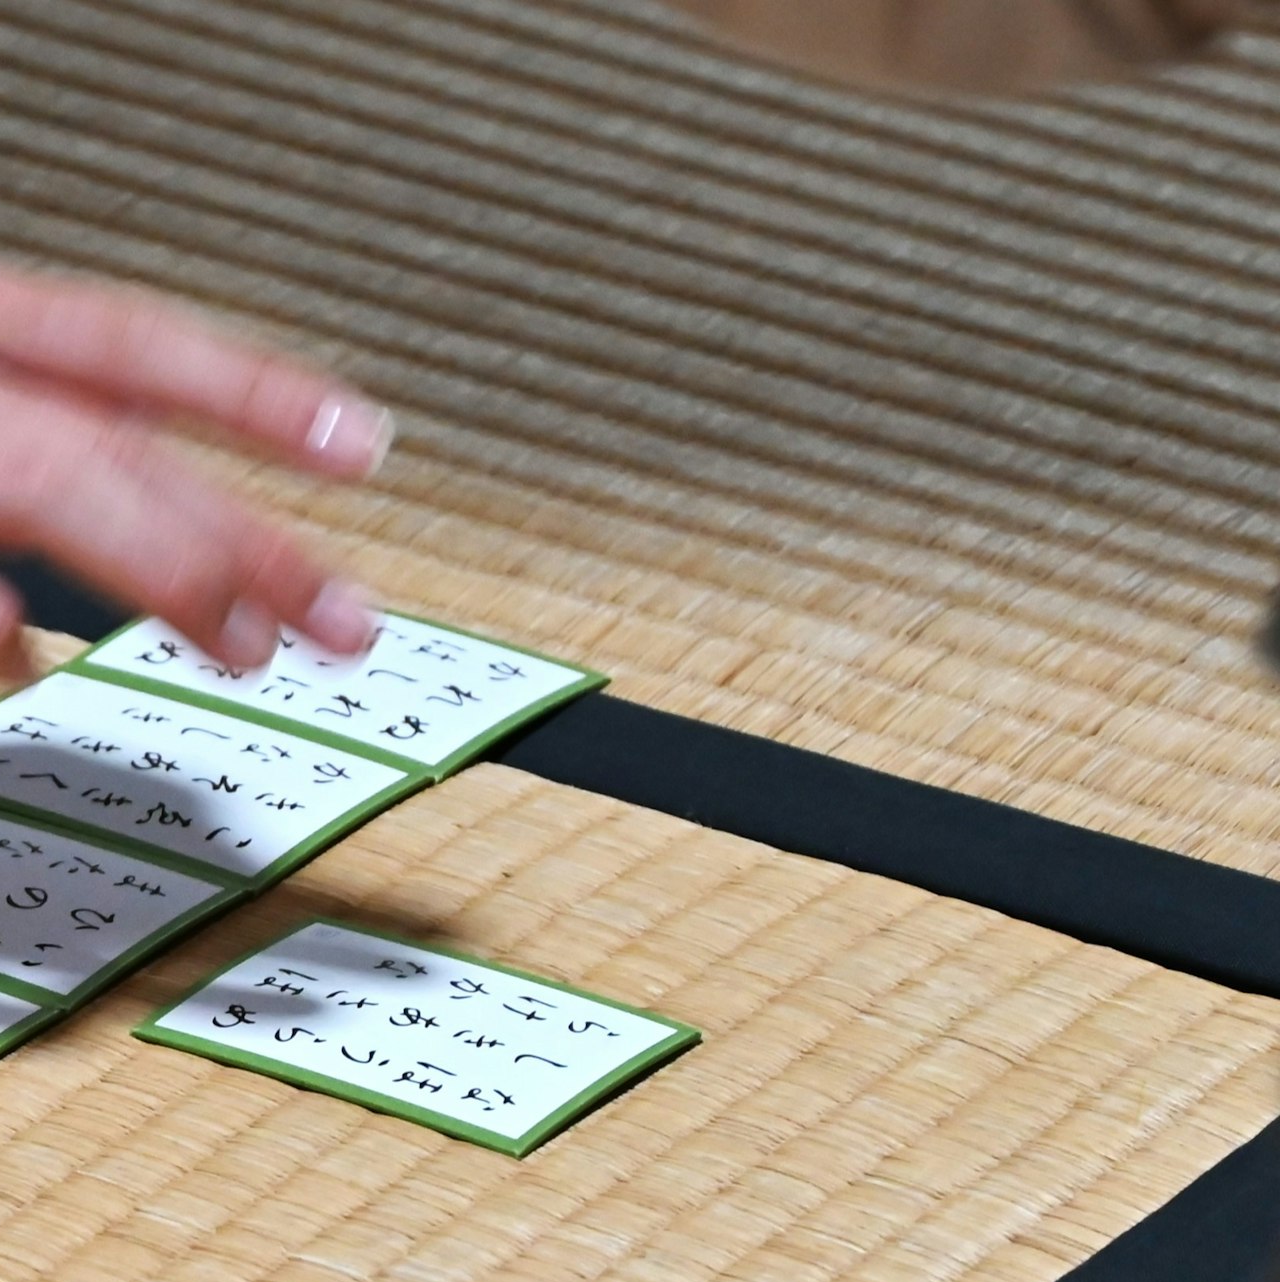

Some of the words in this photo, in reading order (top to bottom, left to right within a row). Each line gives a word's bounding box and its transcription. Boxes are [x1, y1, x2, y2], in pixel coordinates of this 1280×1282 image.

[3, 715, 306, 812] きそあきは
[122, 708, 350, 784] かなしき
[254, 967, 567, 1069] しきあさほ
[371, 957, 620, 1038] らけかな
[212, 1003, 517, 1113] なほうらめ
